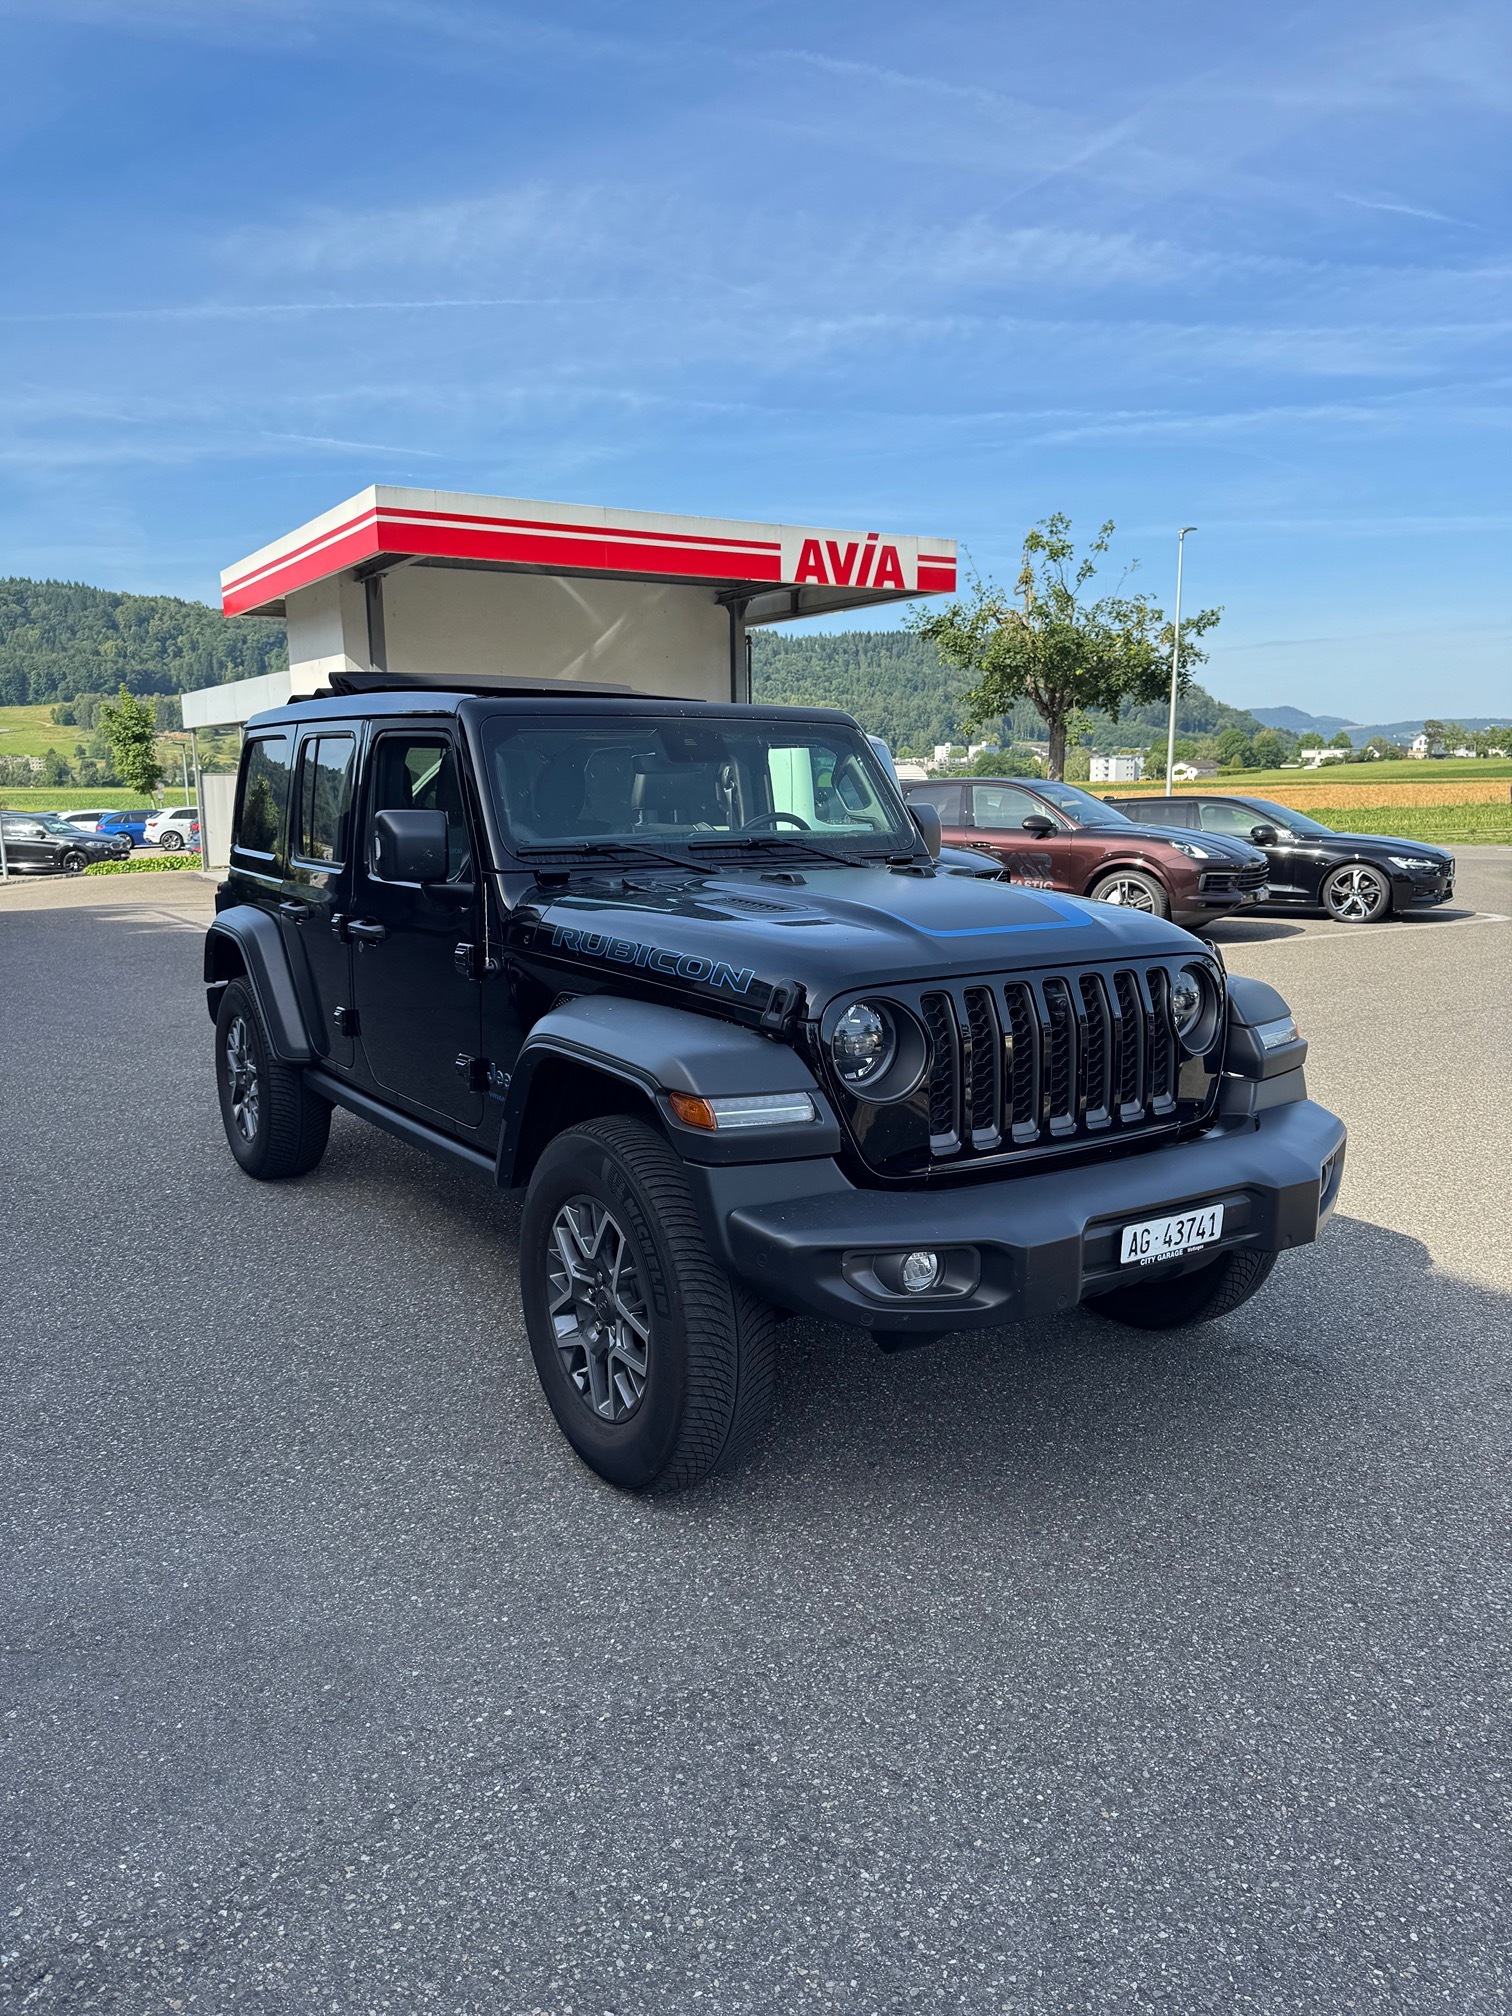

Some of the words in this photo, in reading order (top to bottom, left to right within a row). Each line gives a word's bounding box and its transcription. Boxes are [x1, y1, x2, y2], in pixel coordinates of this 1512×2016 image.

[551, 925, 756, 994] RUBICON
[486, 1062, 513, 1088] Jee
[623, 1197, 669, 1315] MICHELIN
[1140, 1254, 1157, 1266] CITY
[1157, 1248, 1184, 1262] GARAGE
